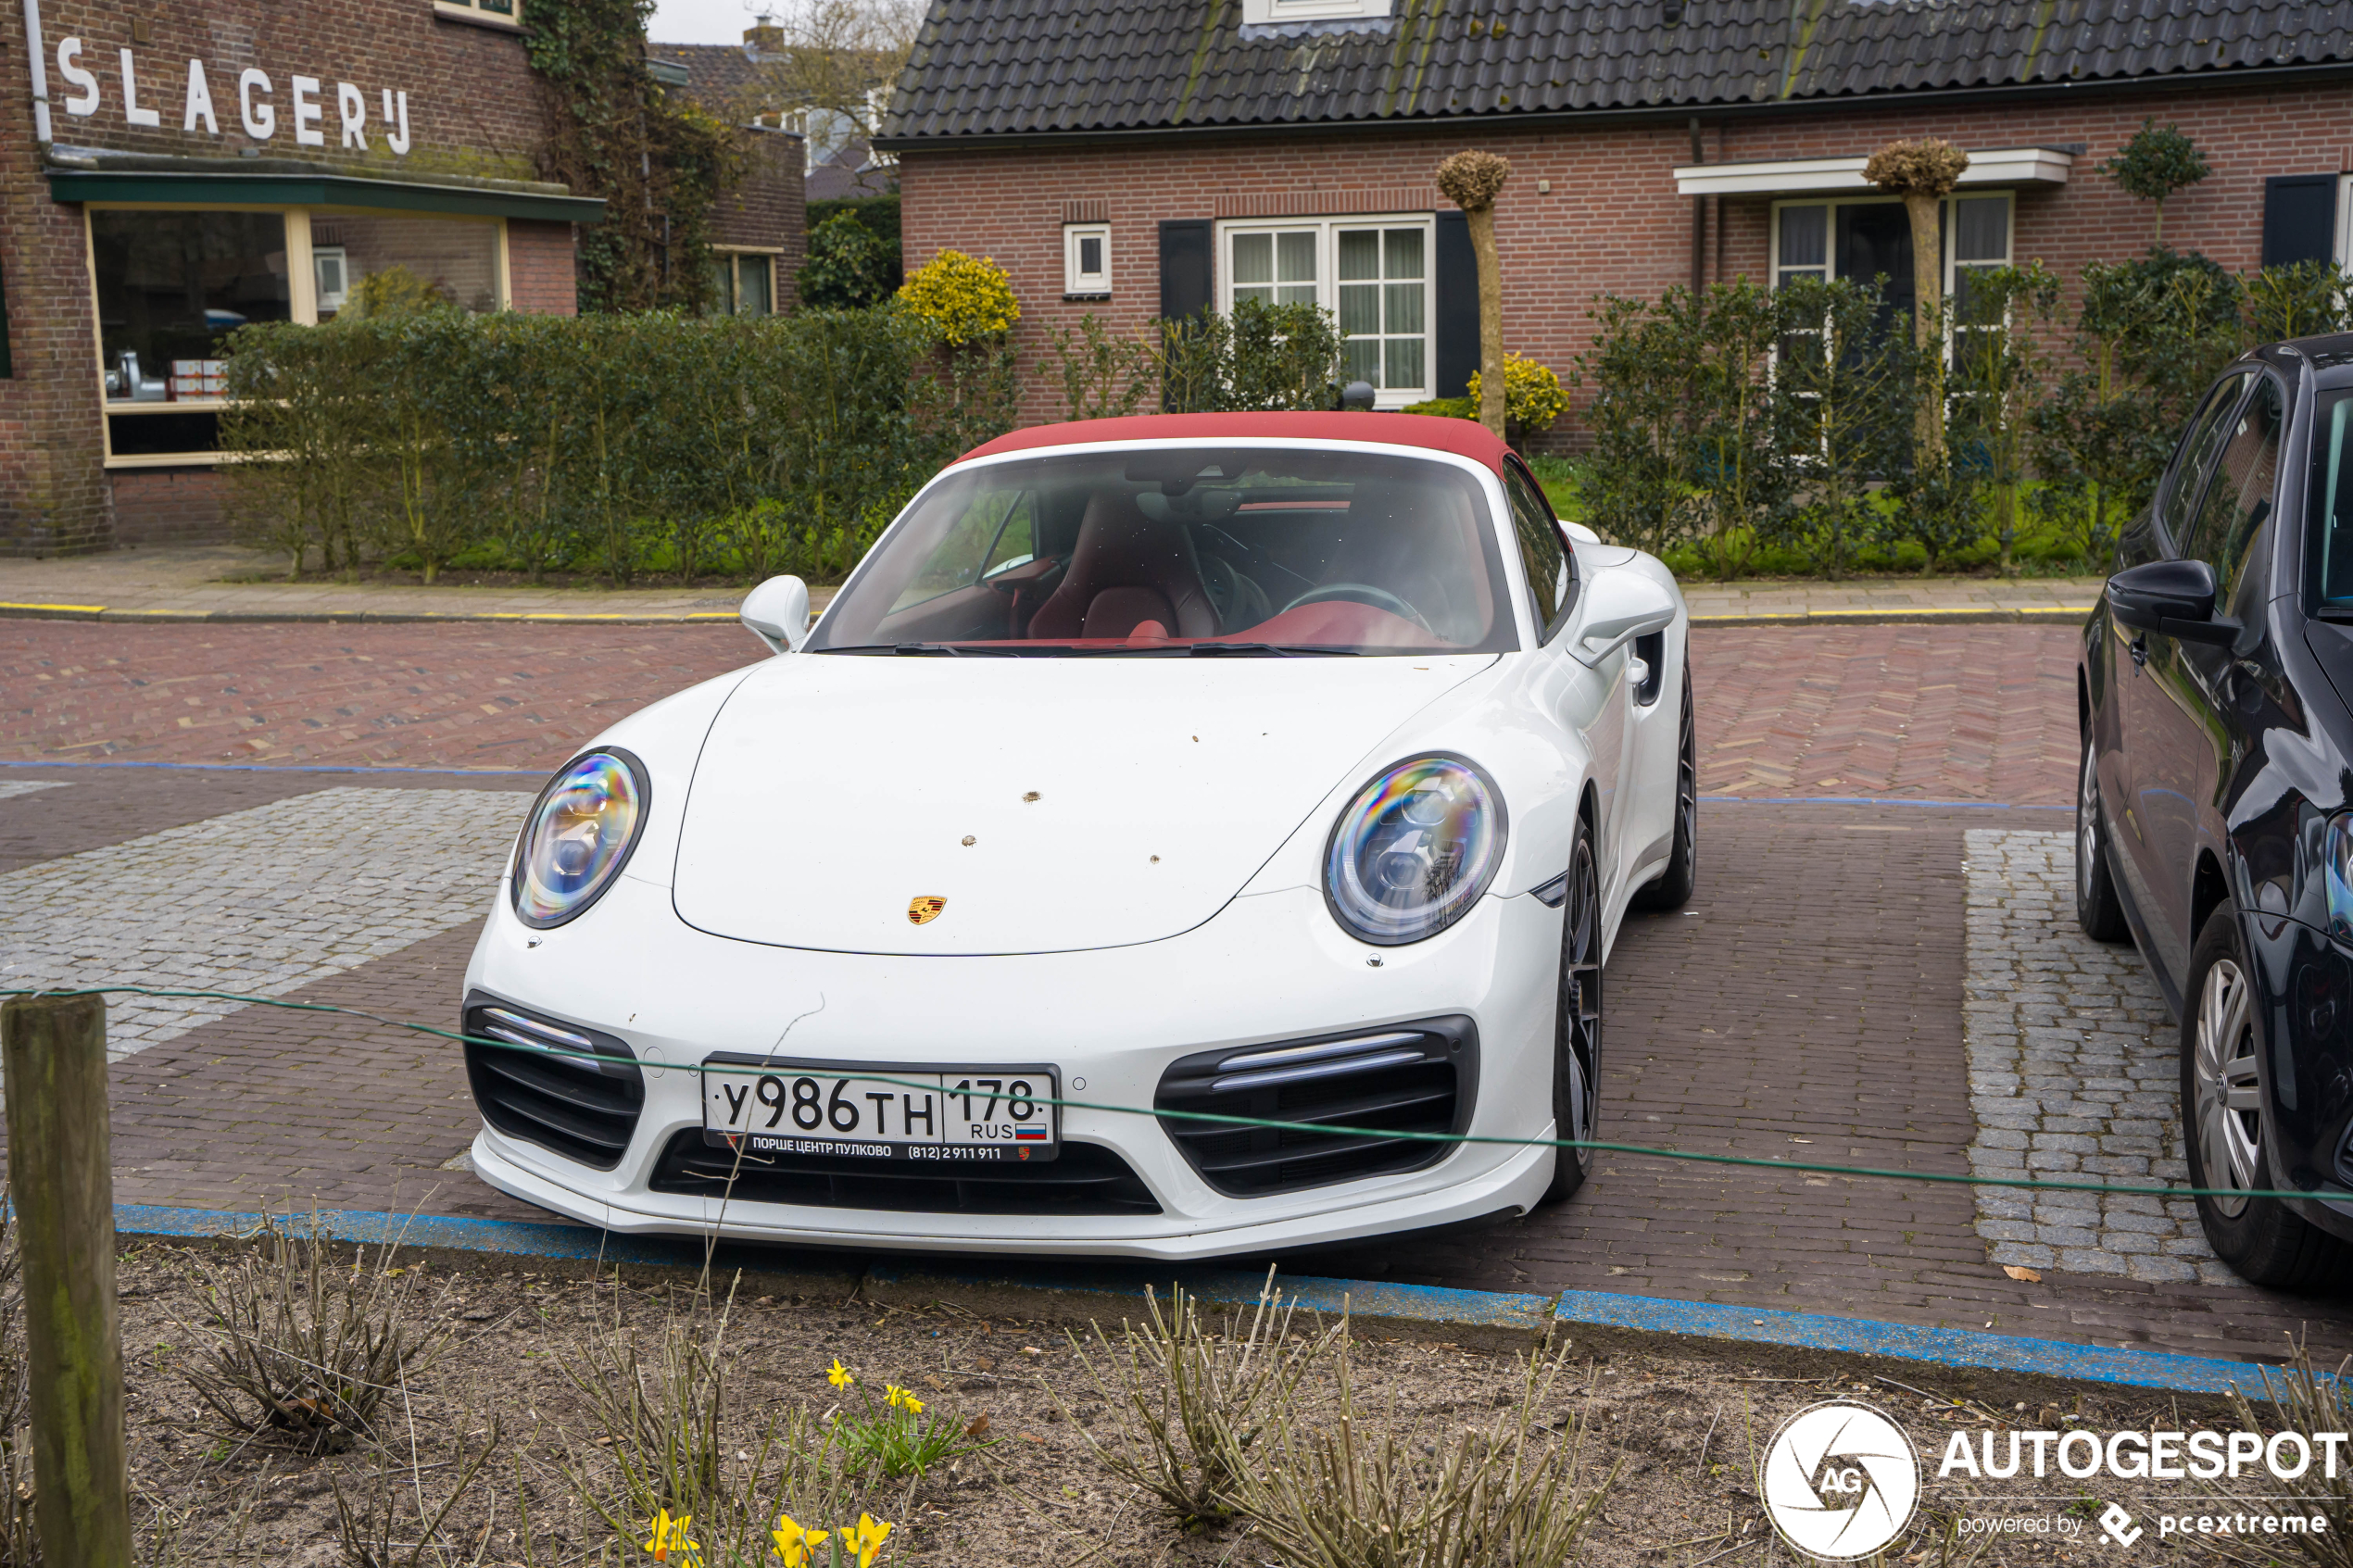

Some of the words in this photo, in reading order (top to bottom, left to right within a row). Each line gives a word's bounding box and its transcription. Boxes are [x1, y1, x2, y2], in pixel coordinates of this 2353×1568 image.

[57, 36, 409, 156] SLAGERIJ
[948, 1079, 1034, 1122] 178
[971, 1123, 1013, 1139] RUS
[752, 1136, 795, 1152] ПОРШЕ
[796, 1140, 834, 1155] ЦЕНТР
[835, 1143, 892, 1157] ПУЛКОВО
[908, 1145, 940, 1160] (812)
